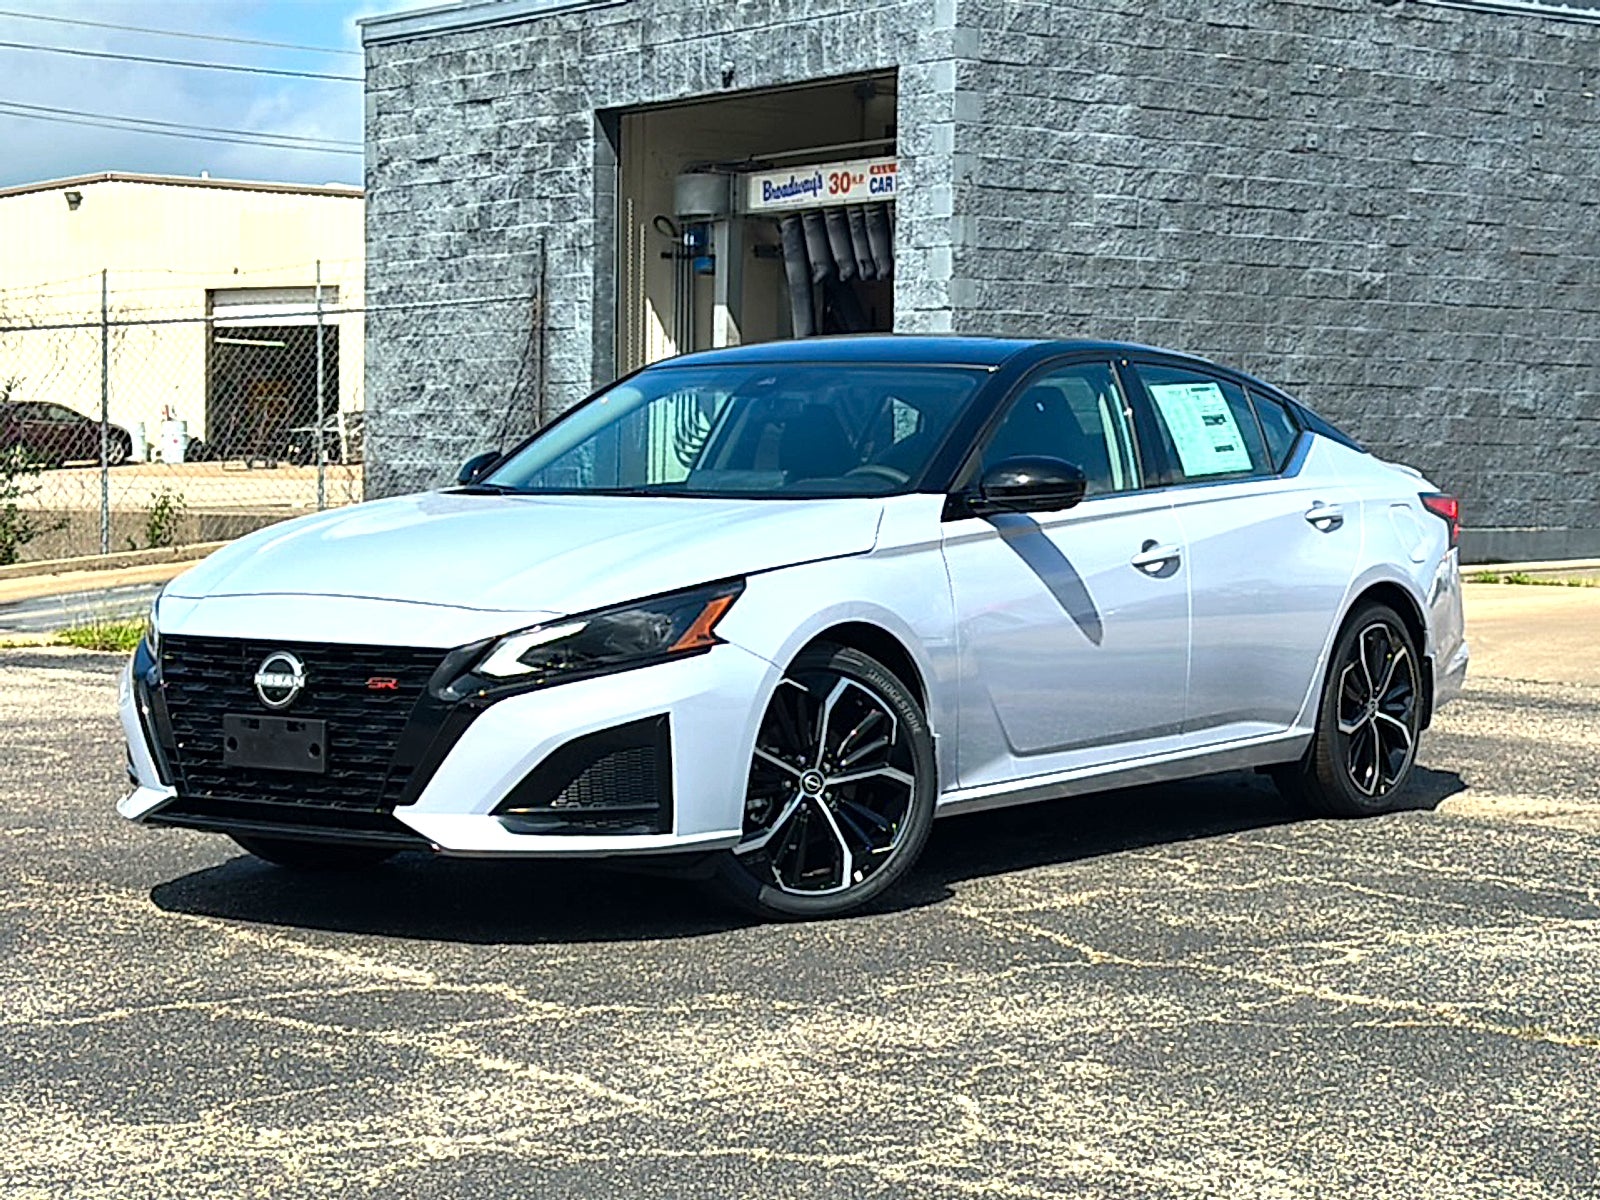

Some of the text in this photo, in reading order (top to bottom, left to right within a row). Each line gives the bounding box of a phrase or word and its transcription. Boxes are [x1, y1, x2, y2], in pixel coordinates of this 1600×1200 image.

[763, 170, 823, 201] Broadway's
[829, 171, 851, 194] 30
[870, 176, 893, 194] CAR
[254, 673, 305, 687] NISSAN
[367, 677, 398, 689] SR
